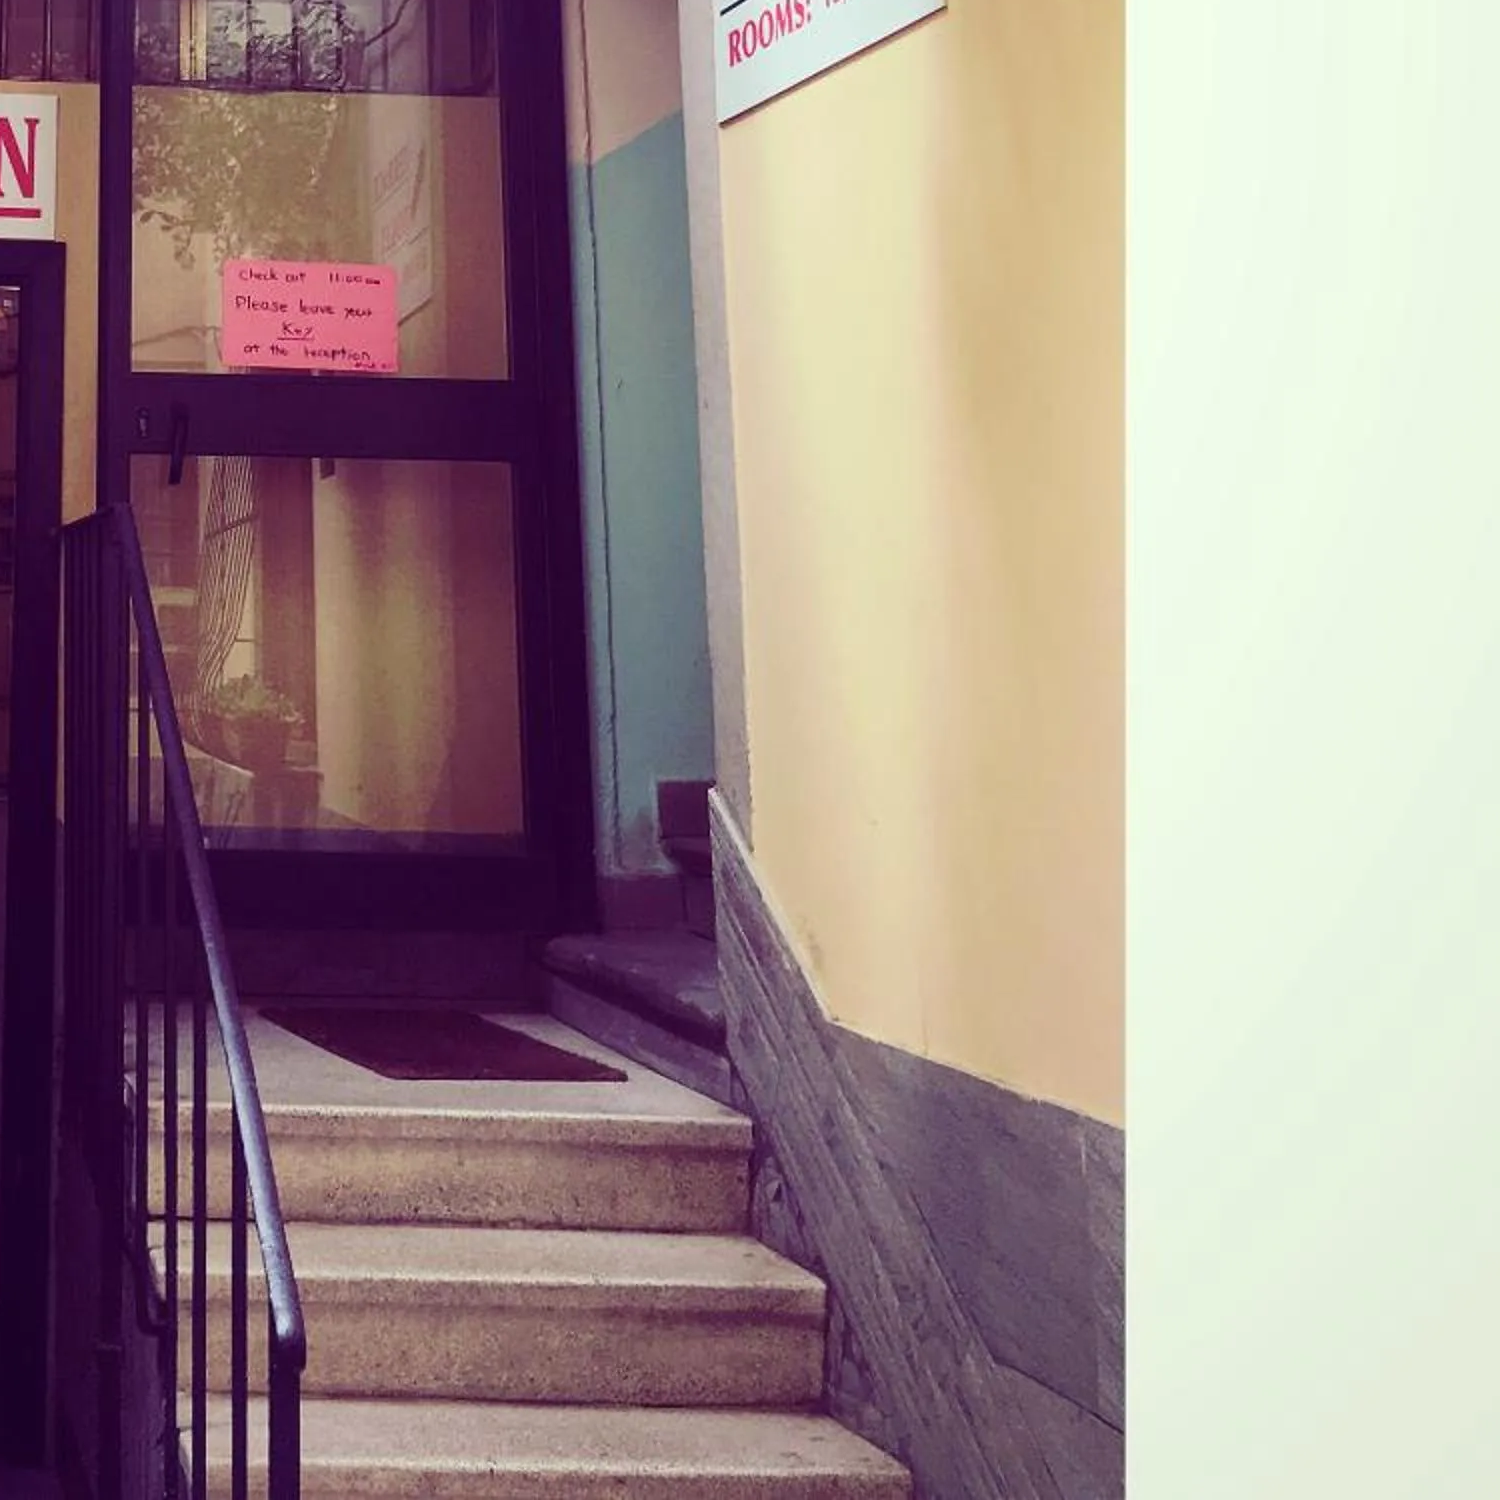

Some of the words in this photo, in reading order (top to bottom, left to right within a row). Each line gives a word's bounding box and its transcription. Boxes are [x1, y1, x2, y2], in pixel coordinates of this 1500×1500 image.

[235, 295, 288, 313] Please
[299, 299, 335, 315] leave
[243, 344, 260, 354] at
[270, 344, 289, 356] the
